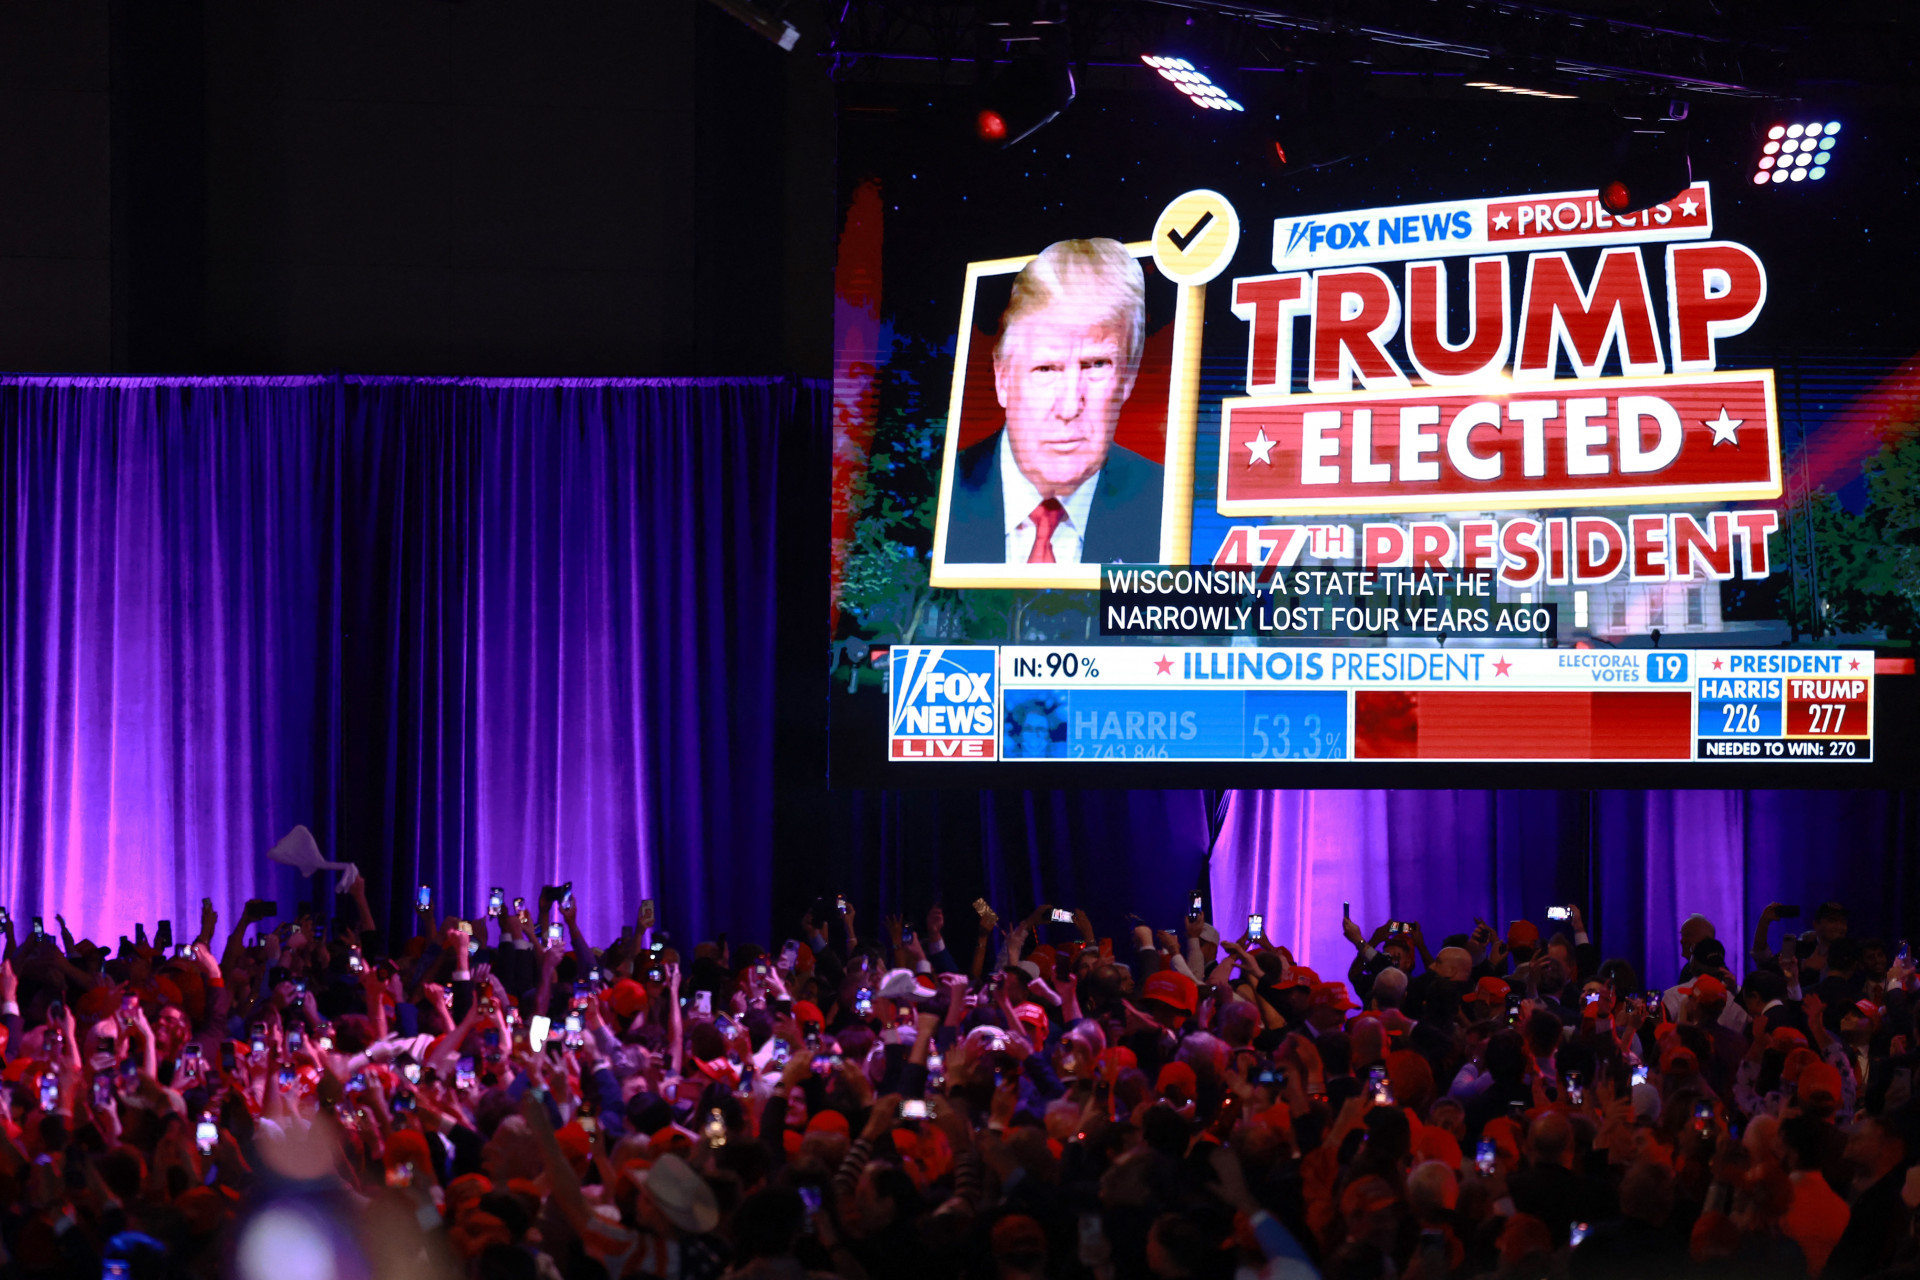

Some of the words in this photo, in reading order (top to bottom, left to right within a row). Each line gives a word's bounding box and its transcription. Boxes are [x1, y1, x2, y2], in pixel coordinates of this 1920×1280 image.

[1309, 219, 1370, 252] FOX
[1378, 211, 1472, 245] NEWS
[1231, 241, 1767, 394] TRUMP
[1301, 396, 1682, 485] ELECTED
[1362, 511, 1777, 587] PRESIDENT
[1107, 569, 1262, 598] WISCONSIN,
[1269, 571, 1287, 595] A
[1294, 571, 1374, 596] STATE
[1380, 572, 1449, 596] THAT
[1456, 573, 1490, 596] HE
[1107, 605, 1252, 630] NARROWLY
[1259, 606, 1325, 631] LOST
[1331, 608, 1400, 631] FOUR
[1407, 608, 1489, 632] YEARS
[1496, 608, 1550, 632] AGO
[1183, 652, 1324, 681] ILLINOIS
[1332, 652, 1485, 681] PRESIDENT
[1558, 655, 1639, 668] ELECTORAL
[1591, 669, 1639, 682] VOTES
[1654, 656, 1682, 679] 19
[1730, 655, 1842, 673] PRESIDENT
[926, 672, 992, 703] FOX
[1701, 680, 1781, 699] HARRIS
[1790, 680, 1865, 699] TRUMP
[906, 705, 993, 734] NEWS
[1074, 711, 1198, 740] HARRIS
[1722, 704, 1760, 732] 226
[1808, 704, 1846, 732] 277
[902, 740, 983, 756] LIVE
[1251, 713, 1342, 758] 53.3%
[1706, 742, 1761, 756] NEEDED
[1764, 742, 1784, 756] TO
[1787, 742, 1824, 756] WIN:
[1829, 742, 1856, 756] 270
